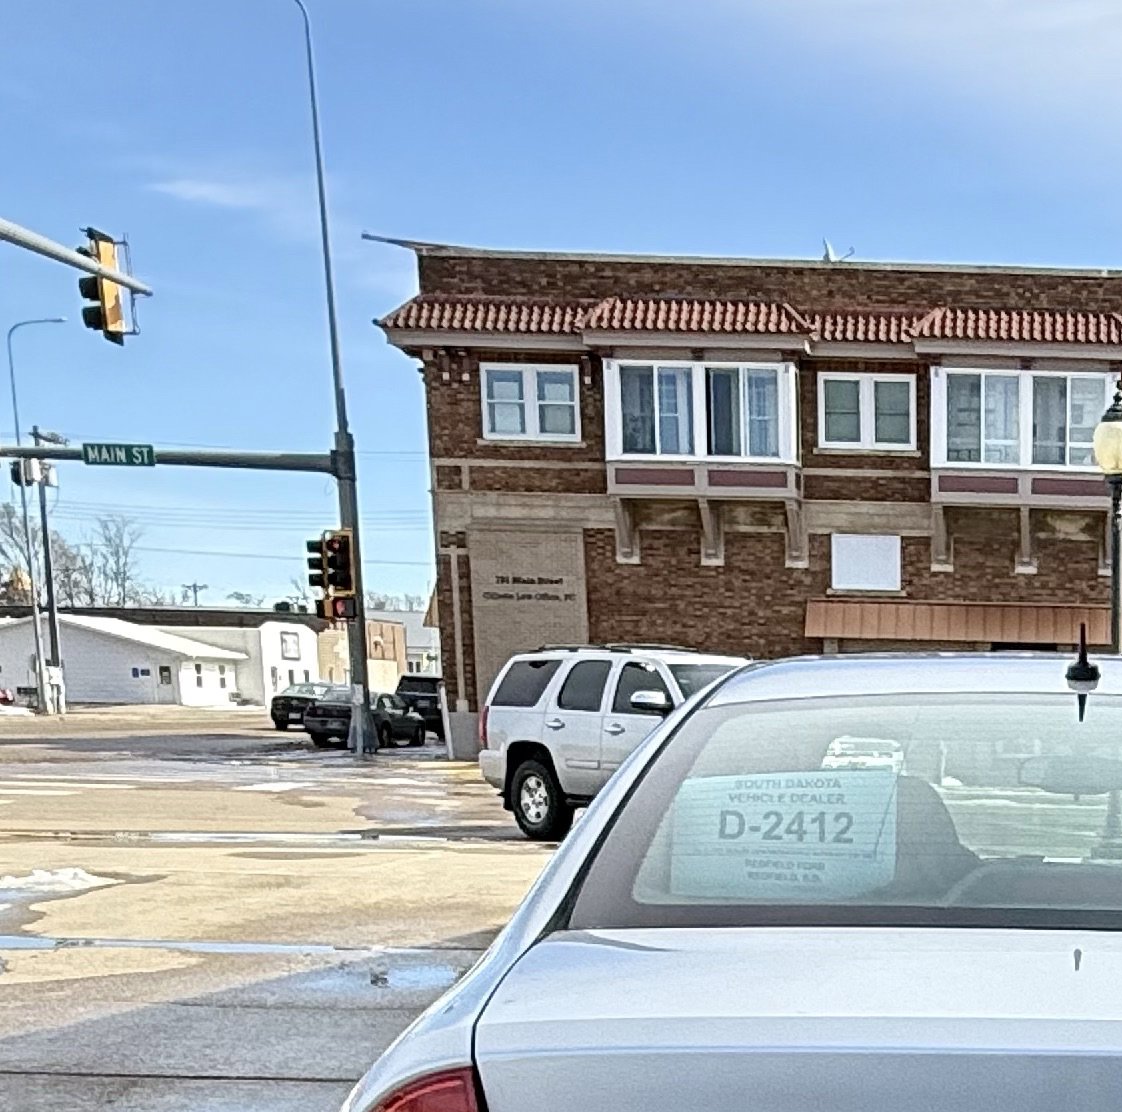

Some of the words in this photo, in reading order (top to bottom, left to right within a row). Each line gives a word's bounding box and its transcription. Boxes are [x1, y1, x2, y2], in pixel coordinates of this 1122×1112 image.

[86, 445, 127, 463] MAIN
[132, 446, 150, 465] ST
[735, 779, 782, 789] SOUTH
[785, 778, 842, 789] DAKOTA
[728, 792, 787, 804] VEHICLE
[789, 793, 846, 805] DEALER
[718, 809, 854, 844] D-2412
[744, 858, 796, 870] REDFIELD
